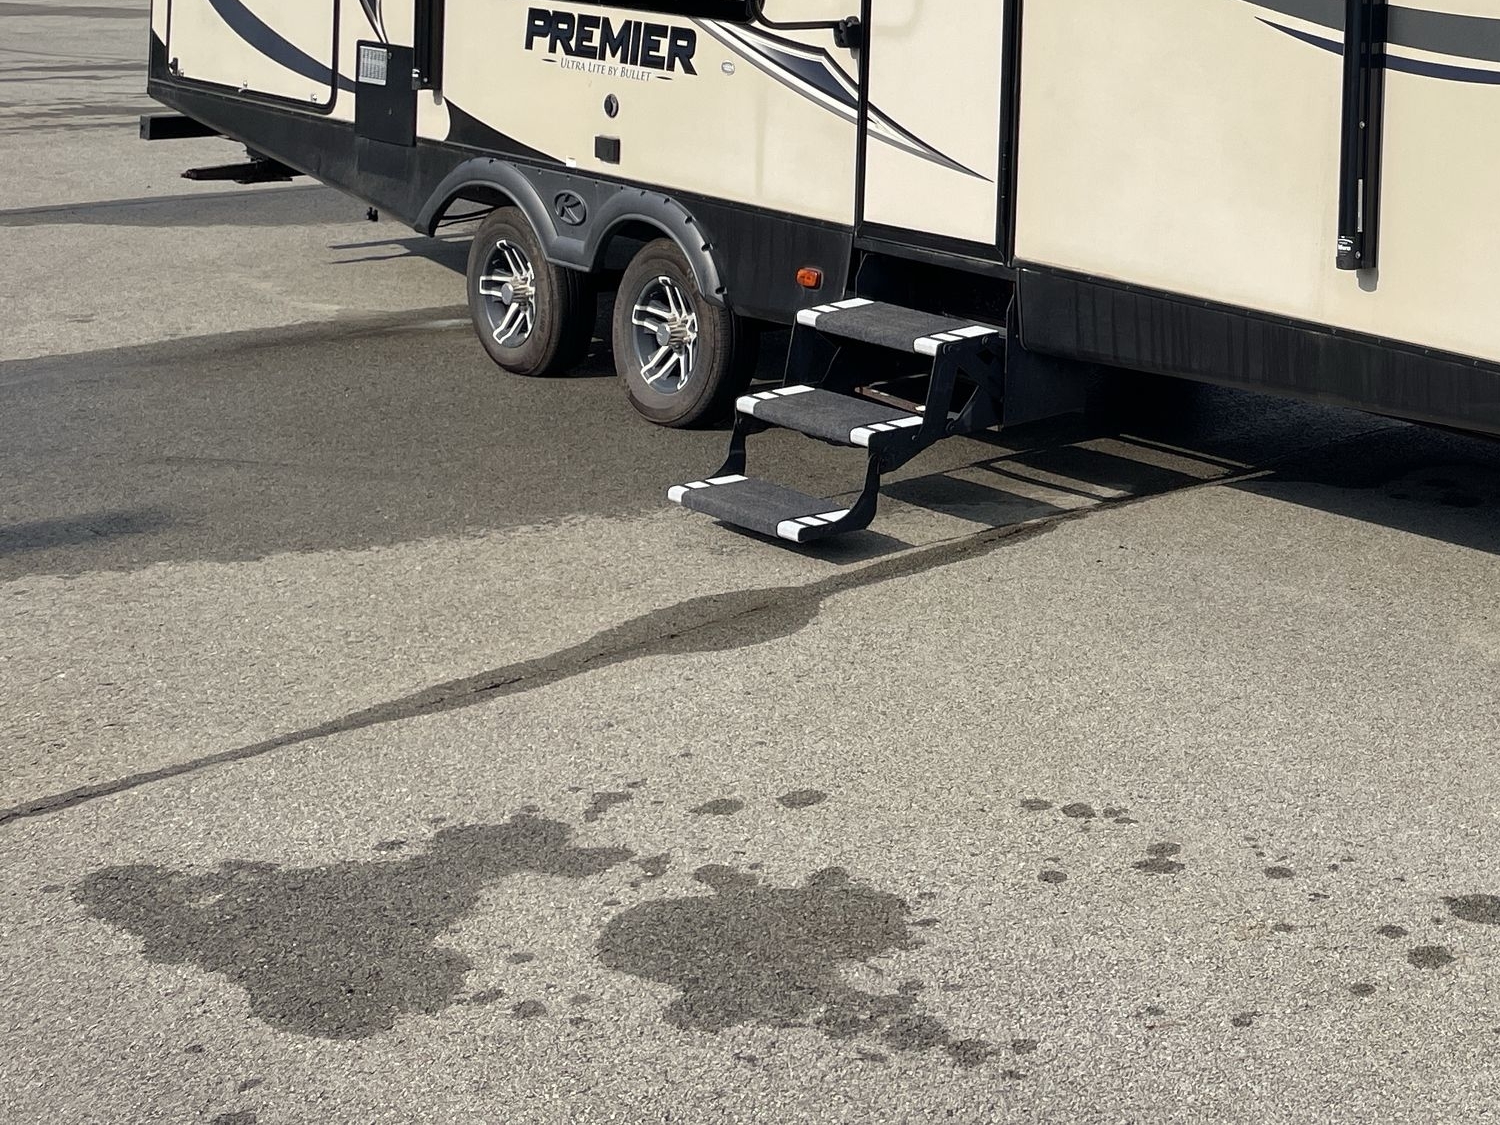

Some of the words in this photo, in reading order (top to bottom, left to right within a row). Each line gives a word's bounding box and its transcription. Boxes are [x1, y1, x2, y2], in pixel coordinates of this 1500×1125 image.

[524, 6, 698, 76] PREMIER
[560, 57, 587, 72] ULTRA
[587, 61, 606, 75] LITE
[620, 66, 652, 82] BULLET
